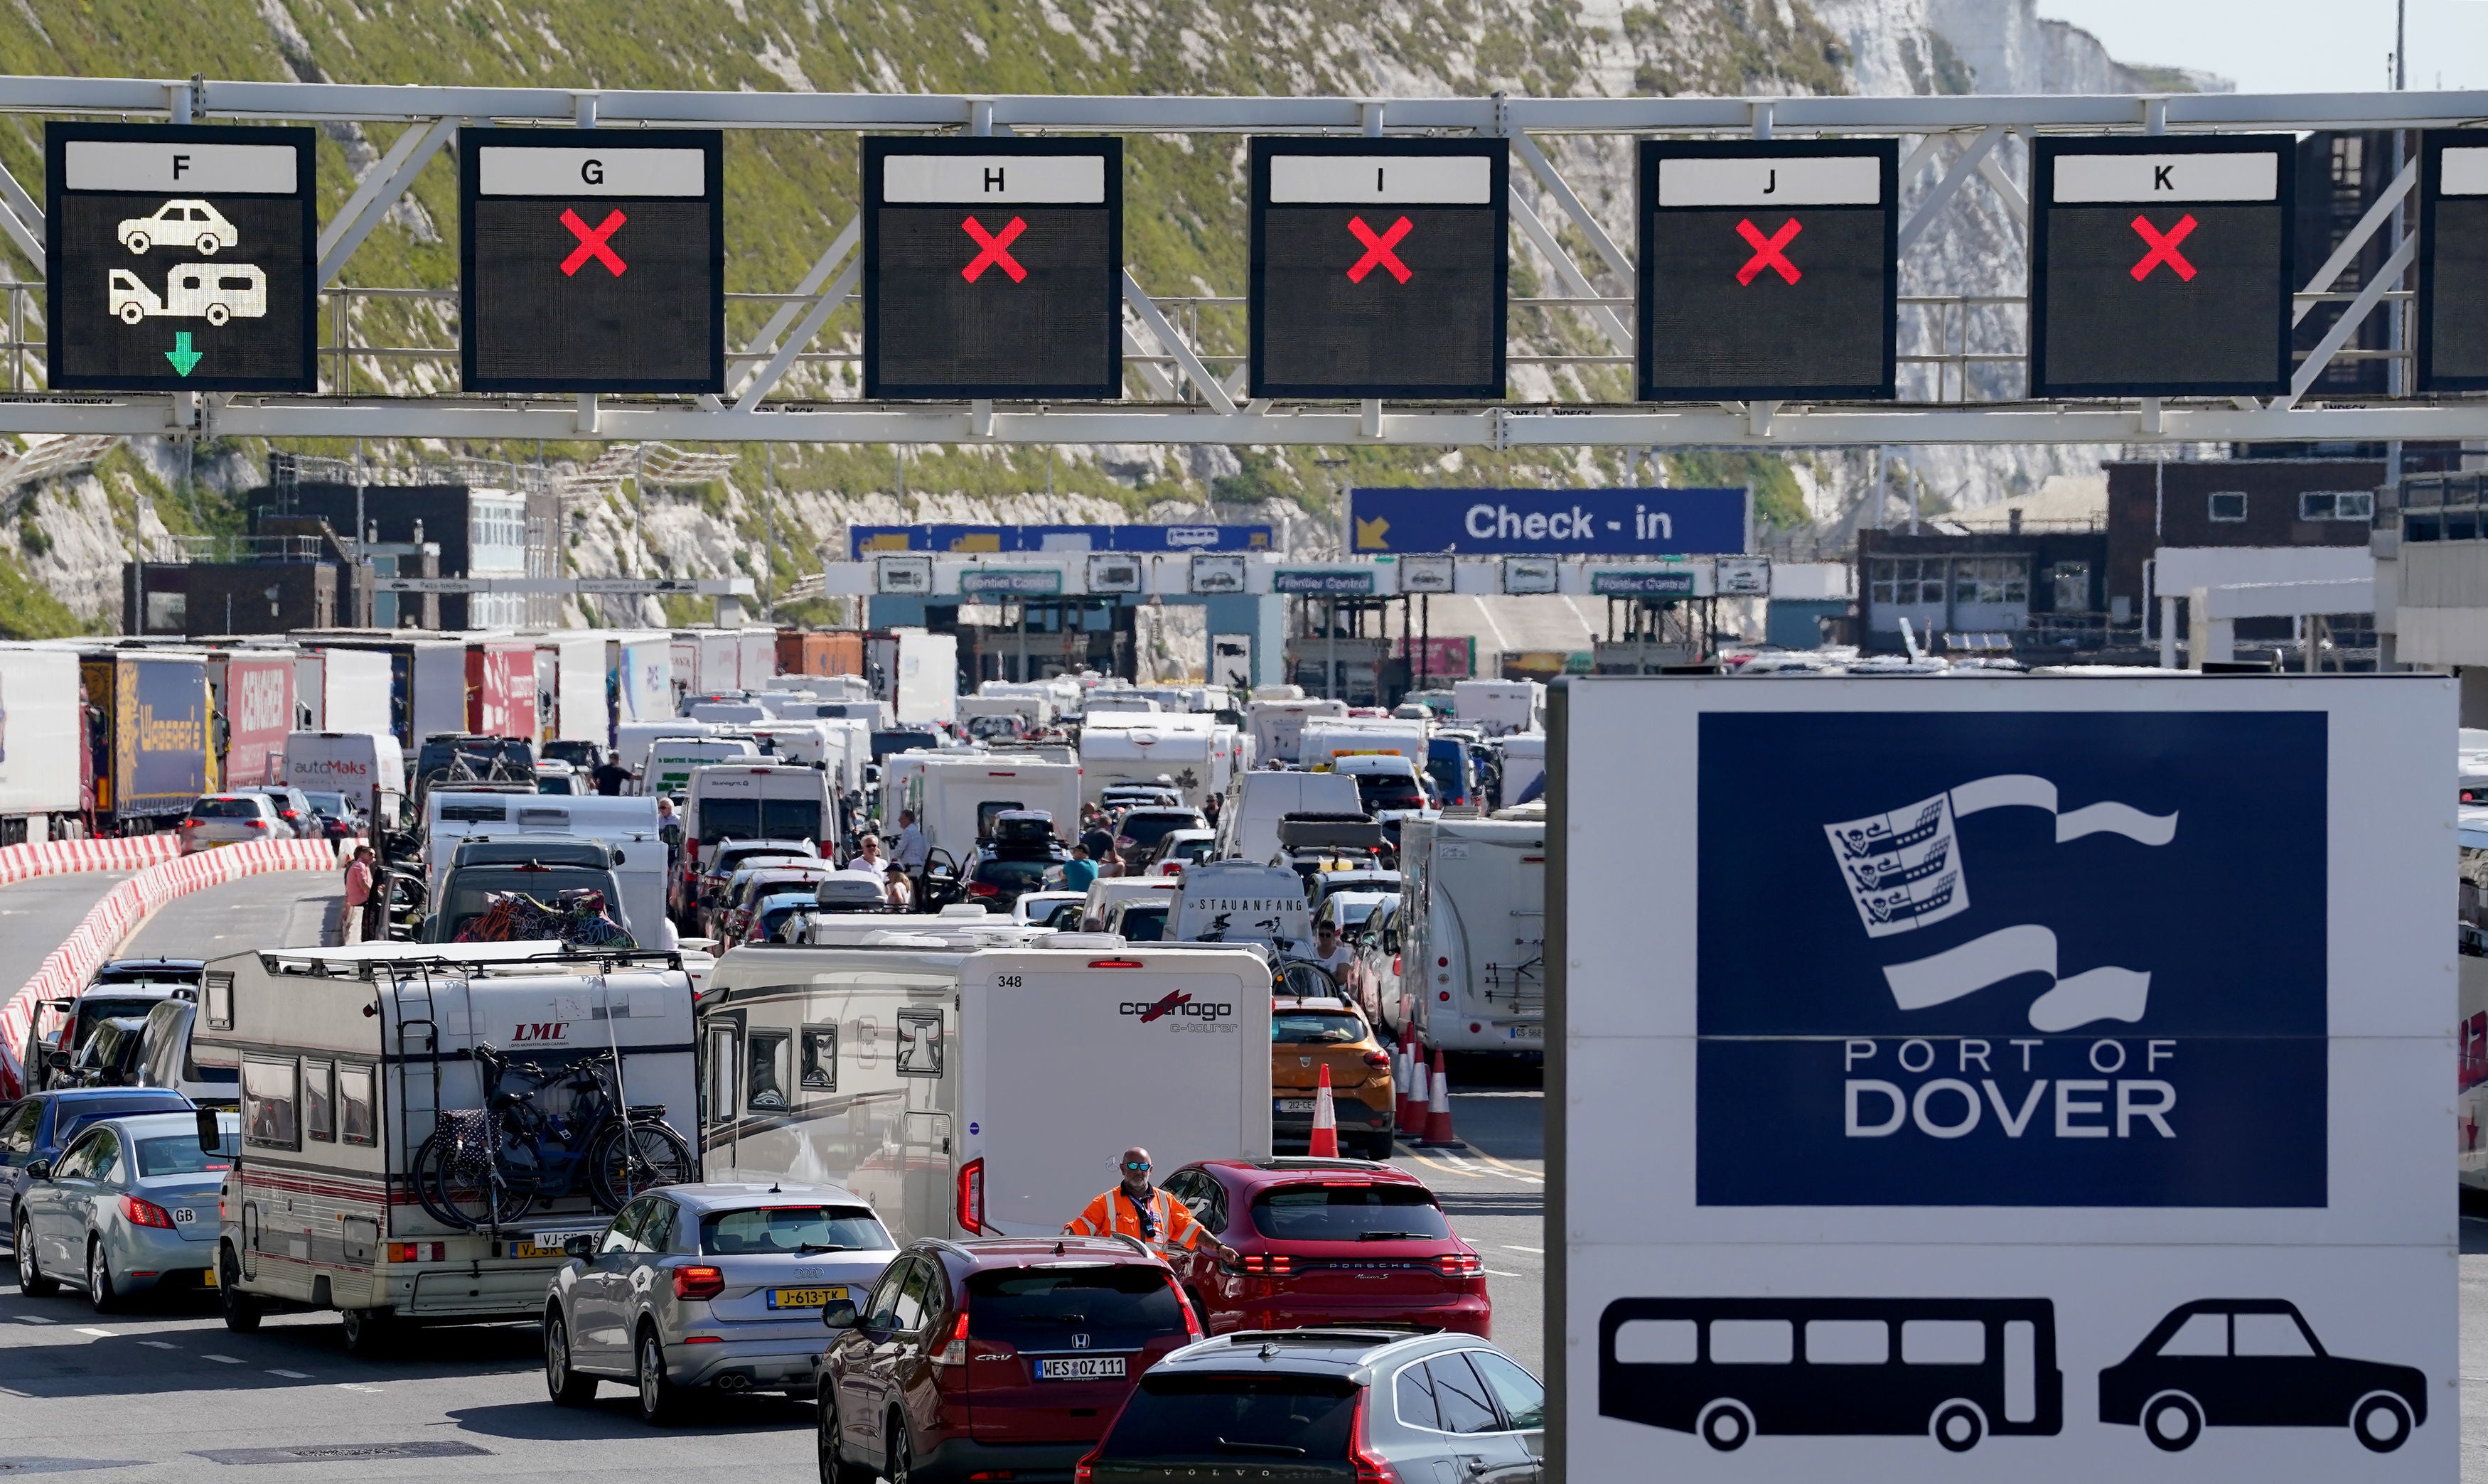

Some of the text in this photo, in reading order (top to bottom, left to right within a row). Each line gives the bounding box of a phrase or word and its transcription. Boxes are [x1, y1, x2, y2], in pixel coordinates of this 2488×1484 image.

[173, 155, 191, 181] F
[581, 158, 604, 185] G
[2154, 165, 2175, 190] K
[984, 167, 1004, 193] H
[1377, 168, 1384, 192] I
[1763, 169, 1776, 194] J
[1465, 504, 1594, 540] Check
[1636, 504, 1672, 540] in
[1277, 576, 1371, 590] Frontier Control
[1597, 576, 1691, 591] Frontier Control
[294, 760, 367, 775] autoMaks
[1199, 898, 1302, 912] STAUANFANG
[997, 975, 1023, 988] 348
[1119, 1001, 1232, 1021] carthago
[511, 1022, 569, 1042] LMC
[1169, 1023, 1238, 1033] c-tourer
[1845, 1039, 2177, 1072] PORT OF
[1845, 1077, 2177, 1139] DOVER
[176, 1209, 193, 1222] GB
[784, 1290, 838, 1304] J-613-TK
[1044, 1361, 1070, 1377] WES
[1079, 1360, 1097, 1375] OZ
[1100, 1359, 1125, 1375] 111
[1164, 1468, 1270, 1478] VOLVO
